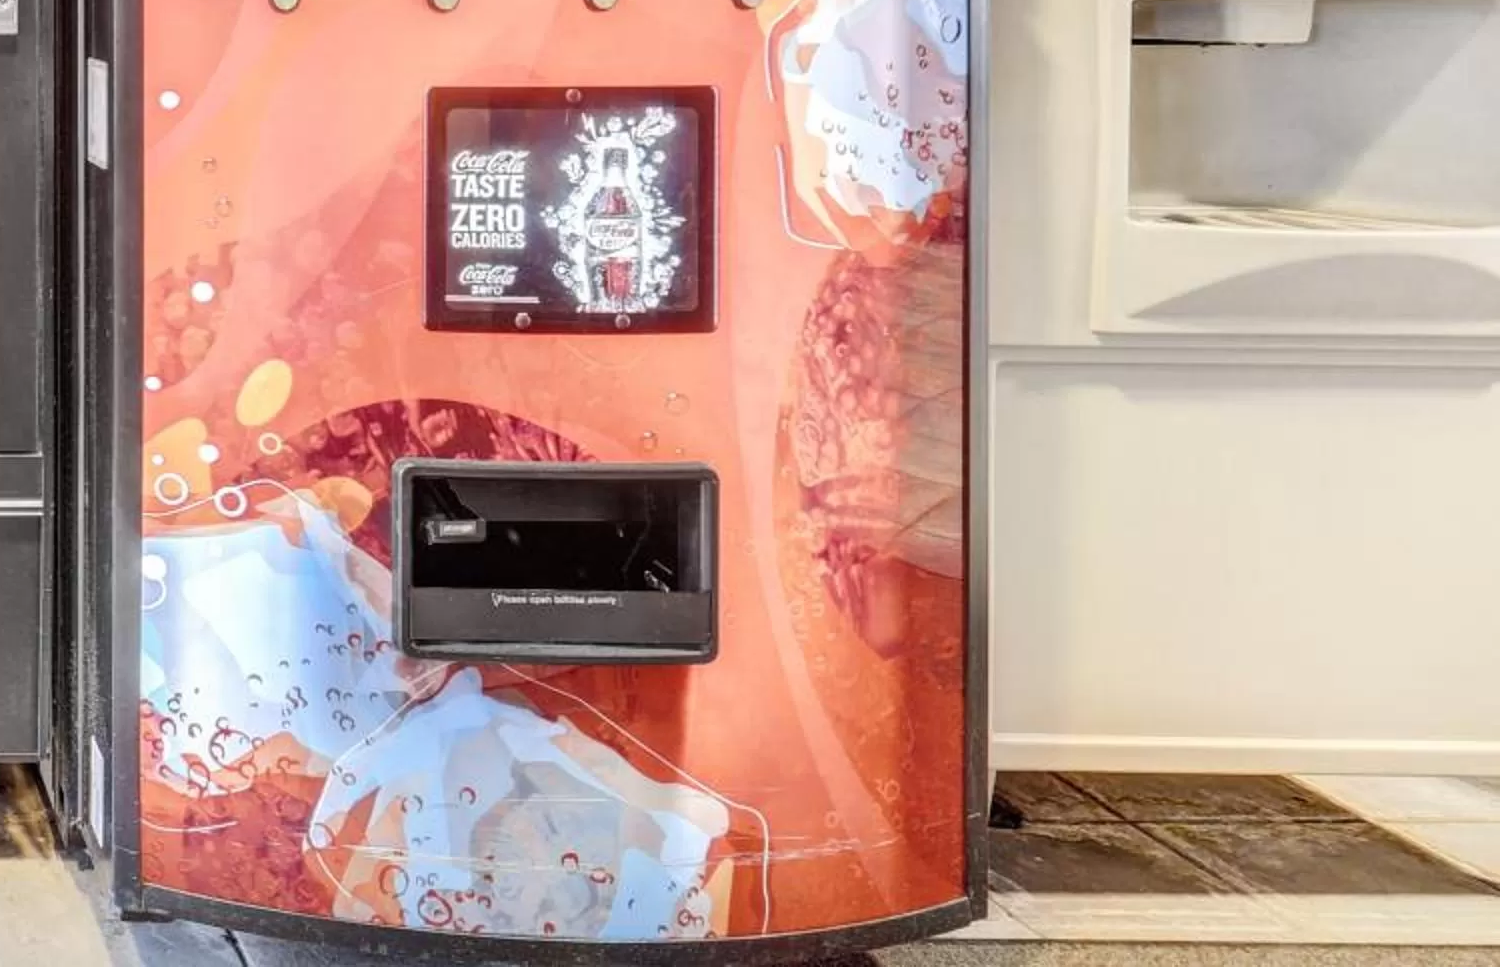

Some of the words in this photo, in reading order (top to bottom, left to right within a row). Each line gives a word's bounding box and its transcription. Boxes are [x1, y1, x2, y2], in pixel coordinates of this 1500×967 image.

[451, 150, 531, 174] Coca-Cola
[451, 174, 525, 198] TASTE
[451, 204, 526, 232] ZERO
[451, 232, 526, 249] CALORIES
[459, 264, 518, 286] Coca-Cola
